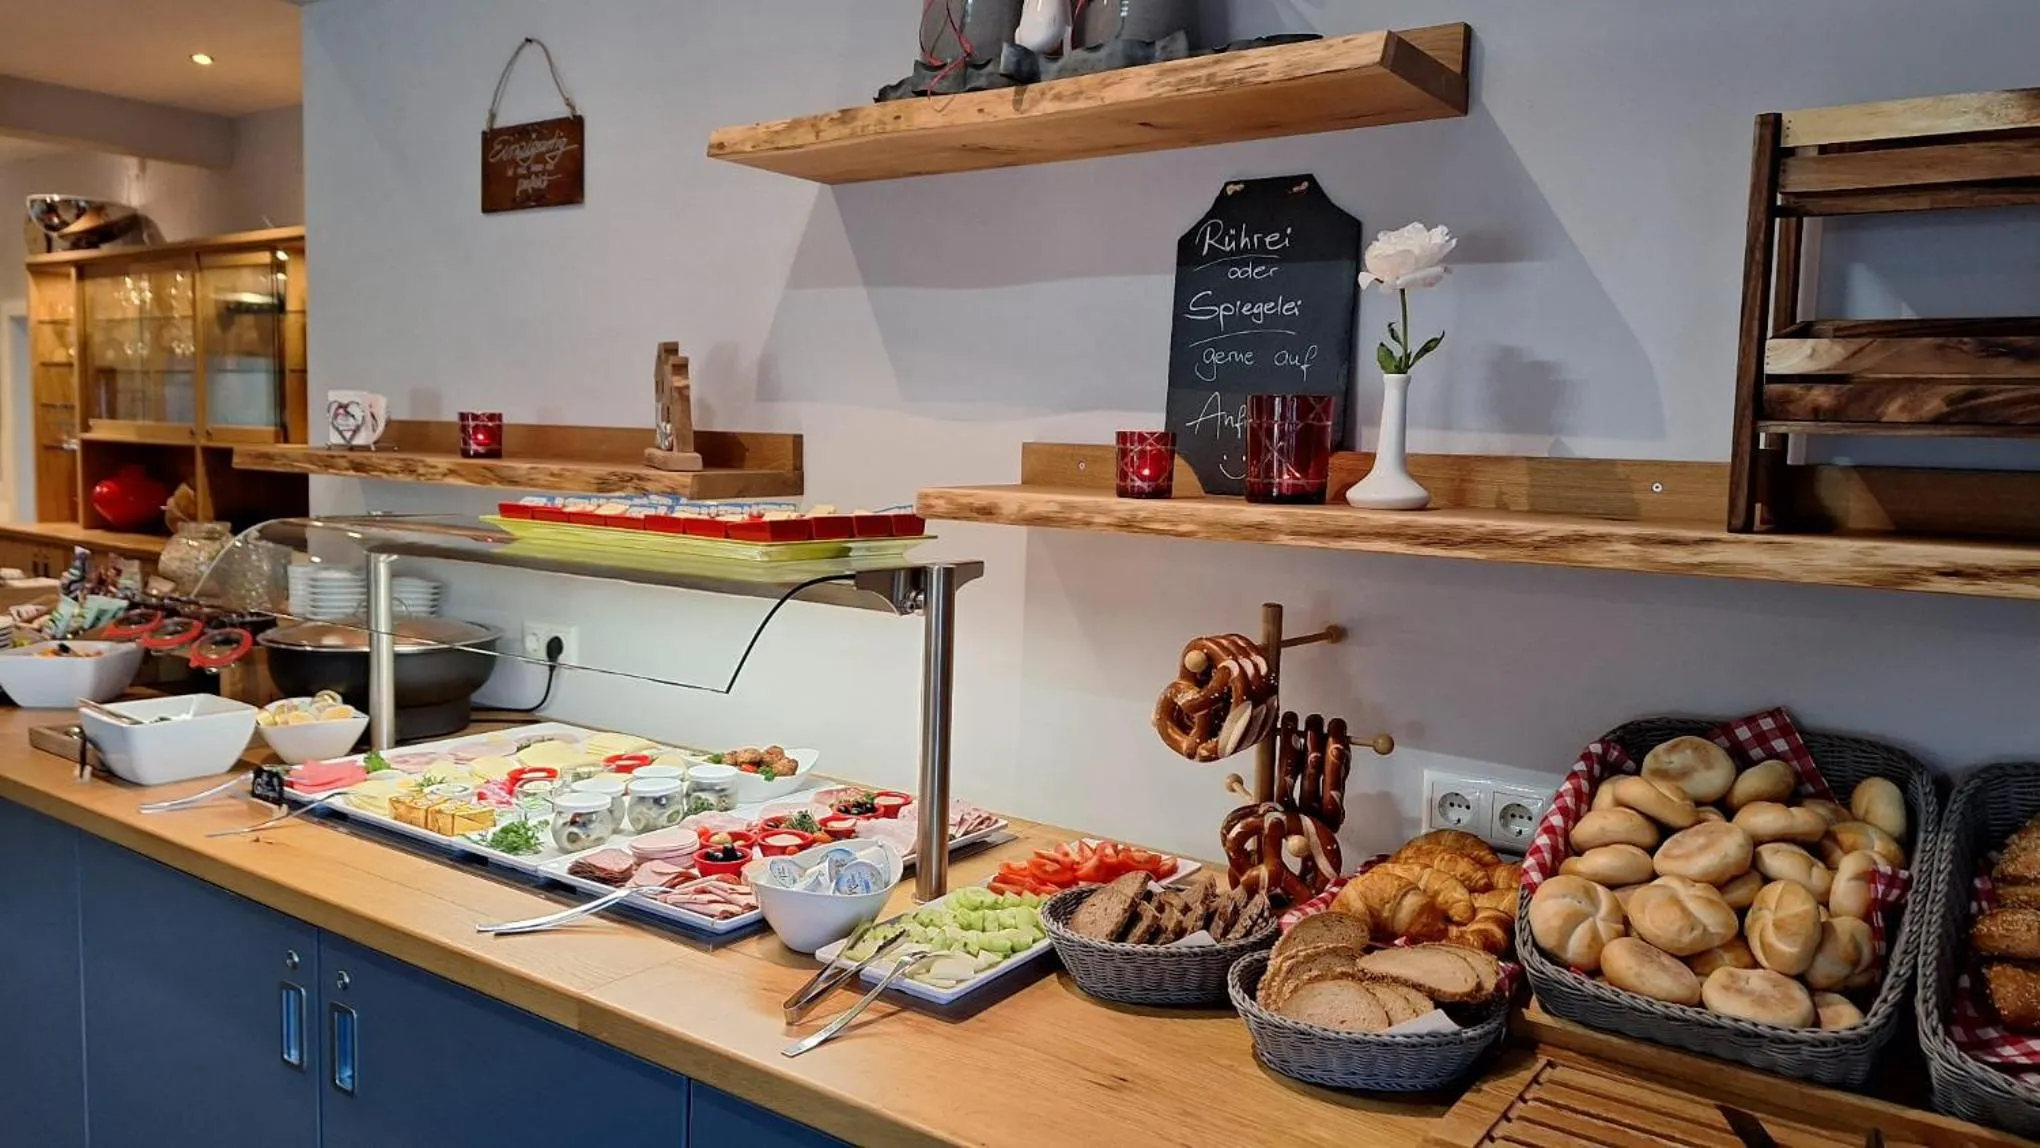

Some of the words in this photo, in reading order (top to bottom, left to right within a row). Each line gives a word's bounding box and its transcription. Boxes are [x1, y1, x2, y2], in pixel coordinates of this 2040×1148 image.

[1195, 219, 1292, 256] Rührei
[1227, 262, 1280, 279] oder
[1185, 290, 1302, 330] Spiegelei
[1194, 347, 1255, 382] gerne
[1273, 345, 1318, 381] auf
[1185, 391, 1248, 440] Anf
